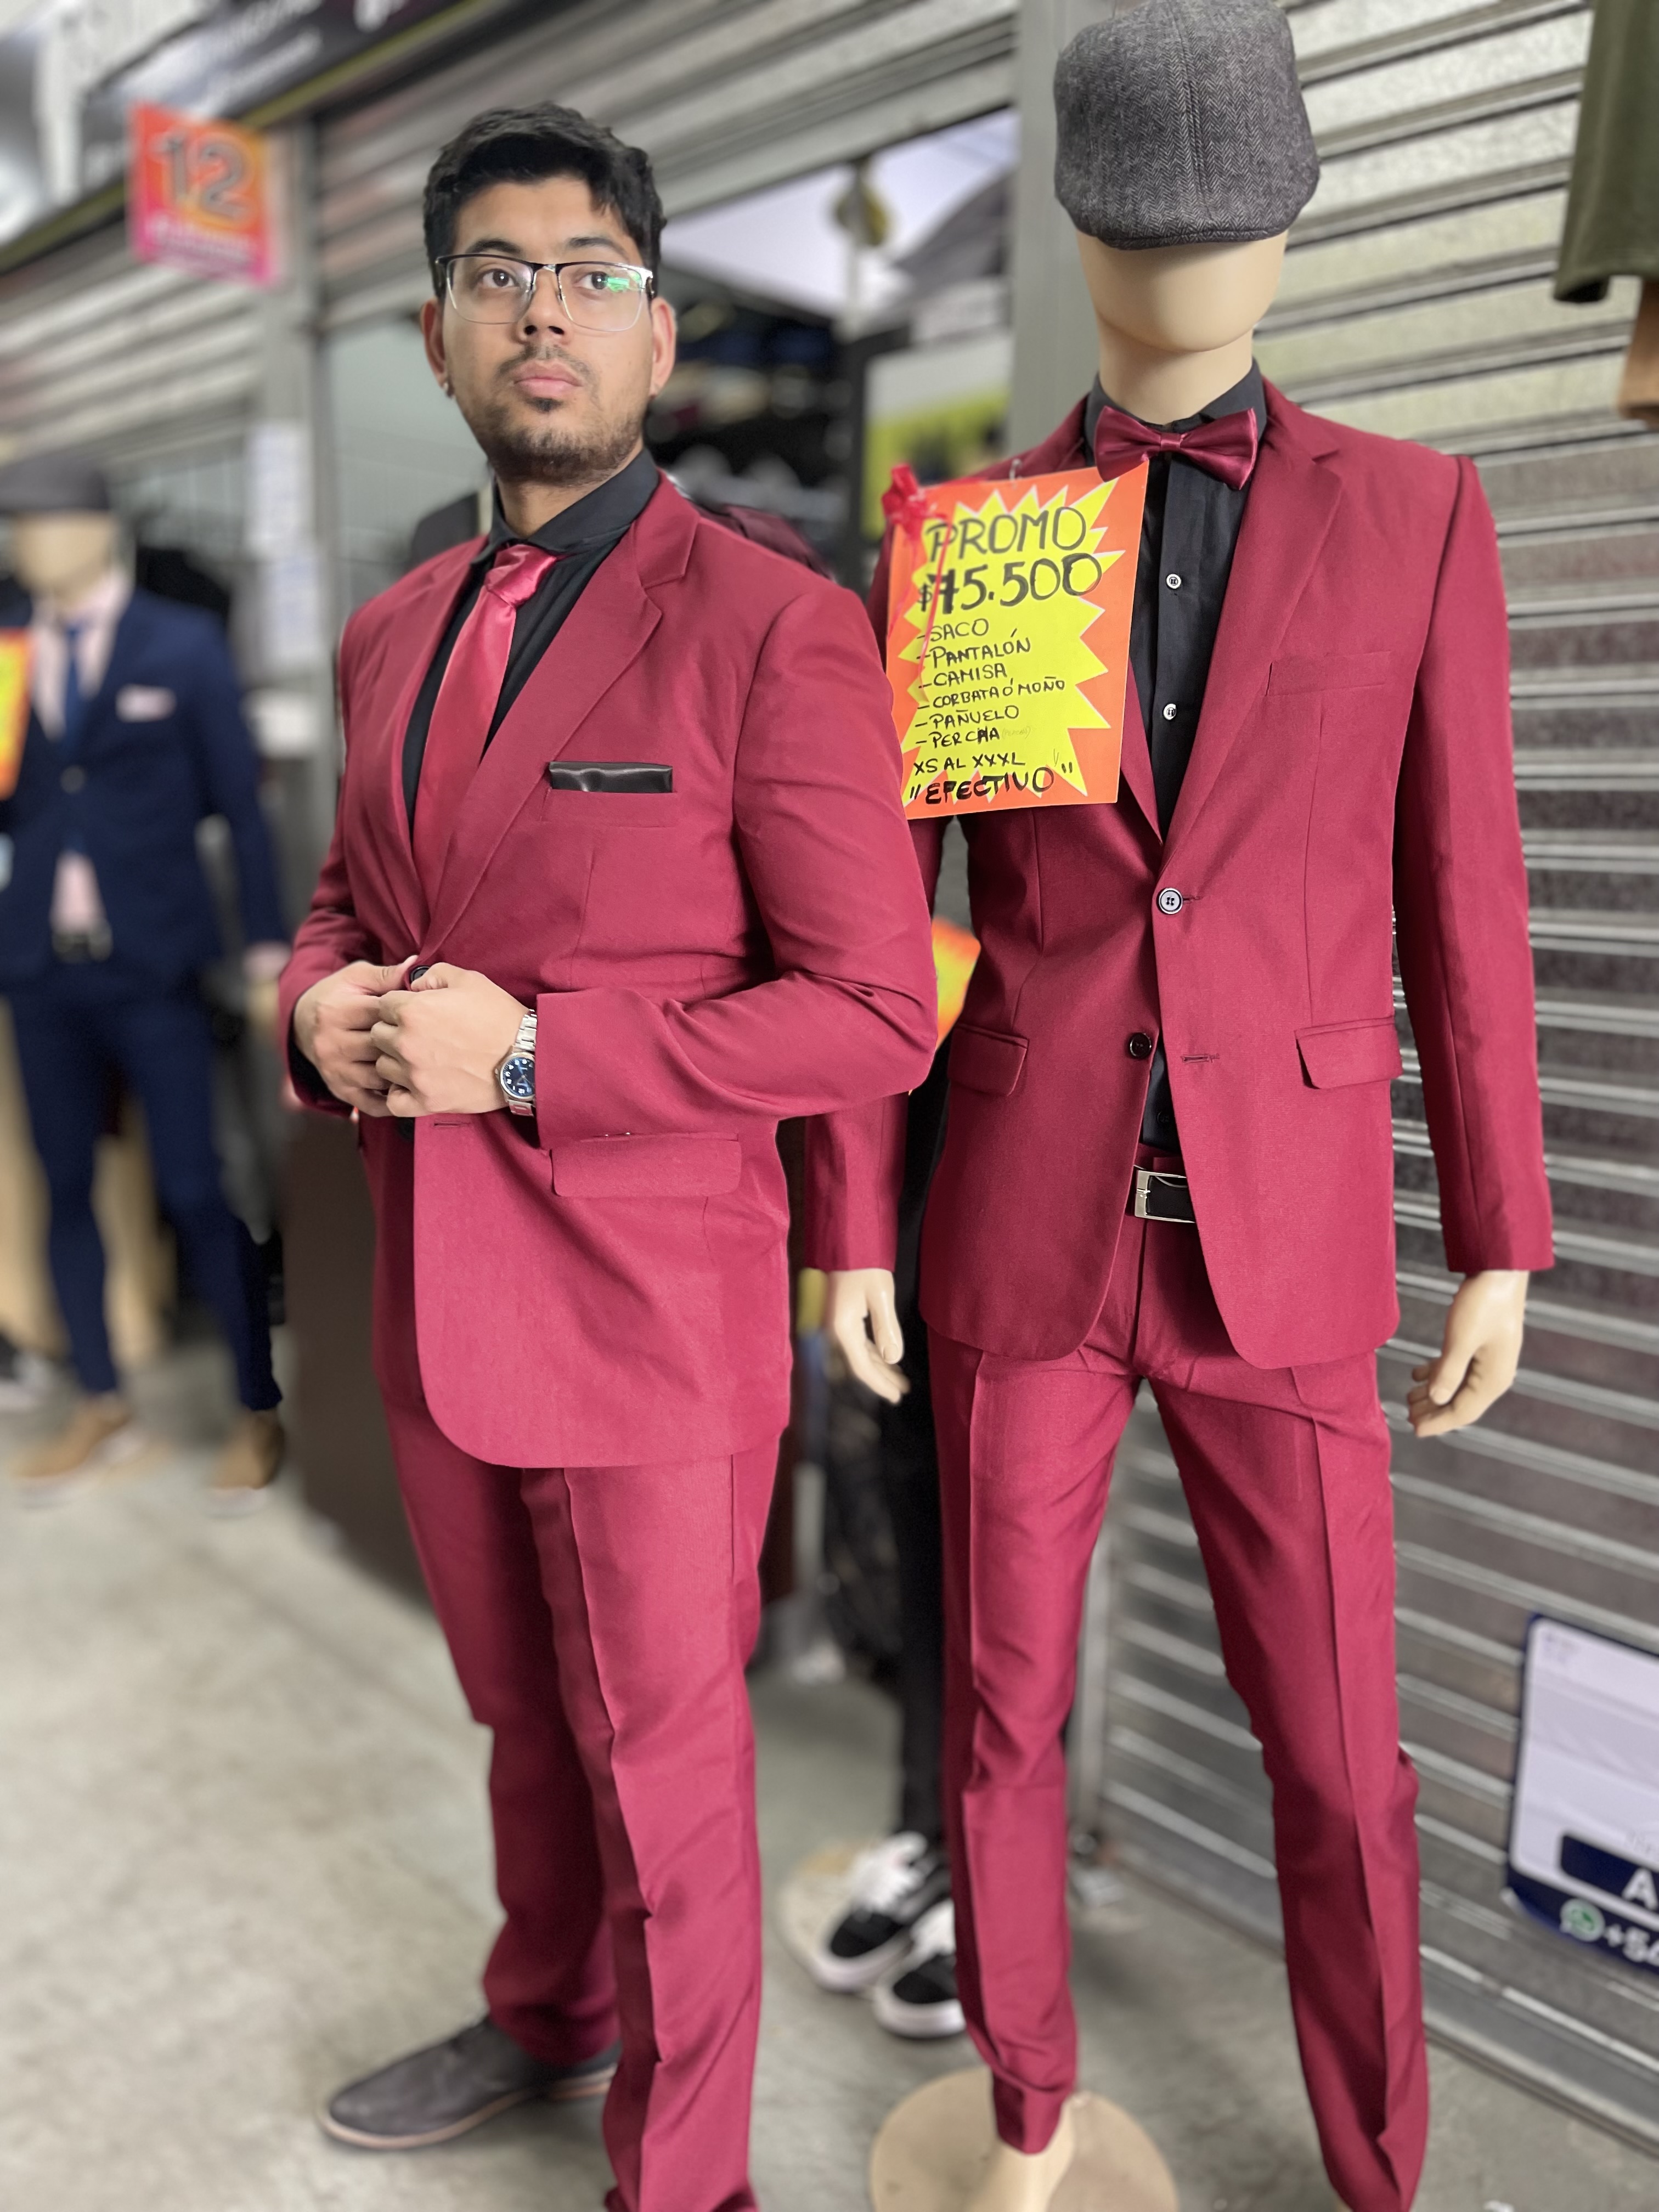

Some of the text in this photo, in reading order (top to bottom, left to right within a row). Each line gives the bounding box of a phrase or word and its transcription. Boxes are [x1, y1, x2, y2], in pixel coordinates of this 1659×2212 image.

[145, 132, 255, 222] 12
[925, 506, 1086, 562] PROMO
[916, 552, 1102, 615] $75.500
[913, 752, 1026, 776] XS AL XXXL
